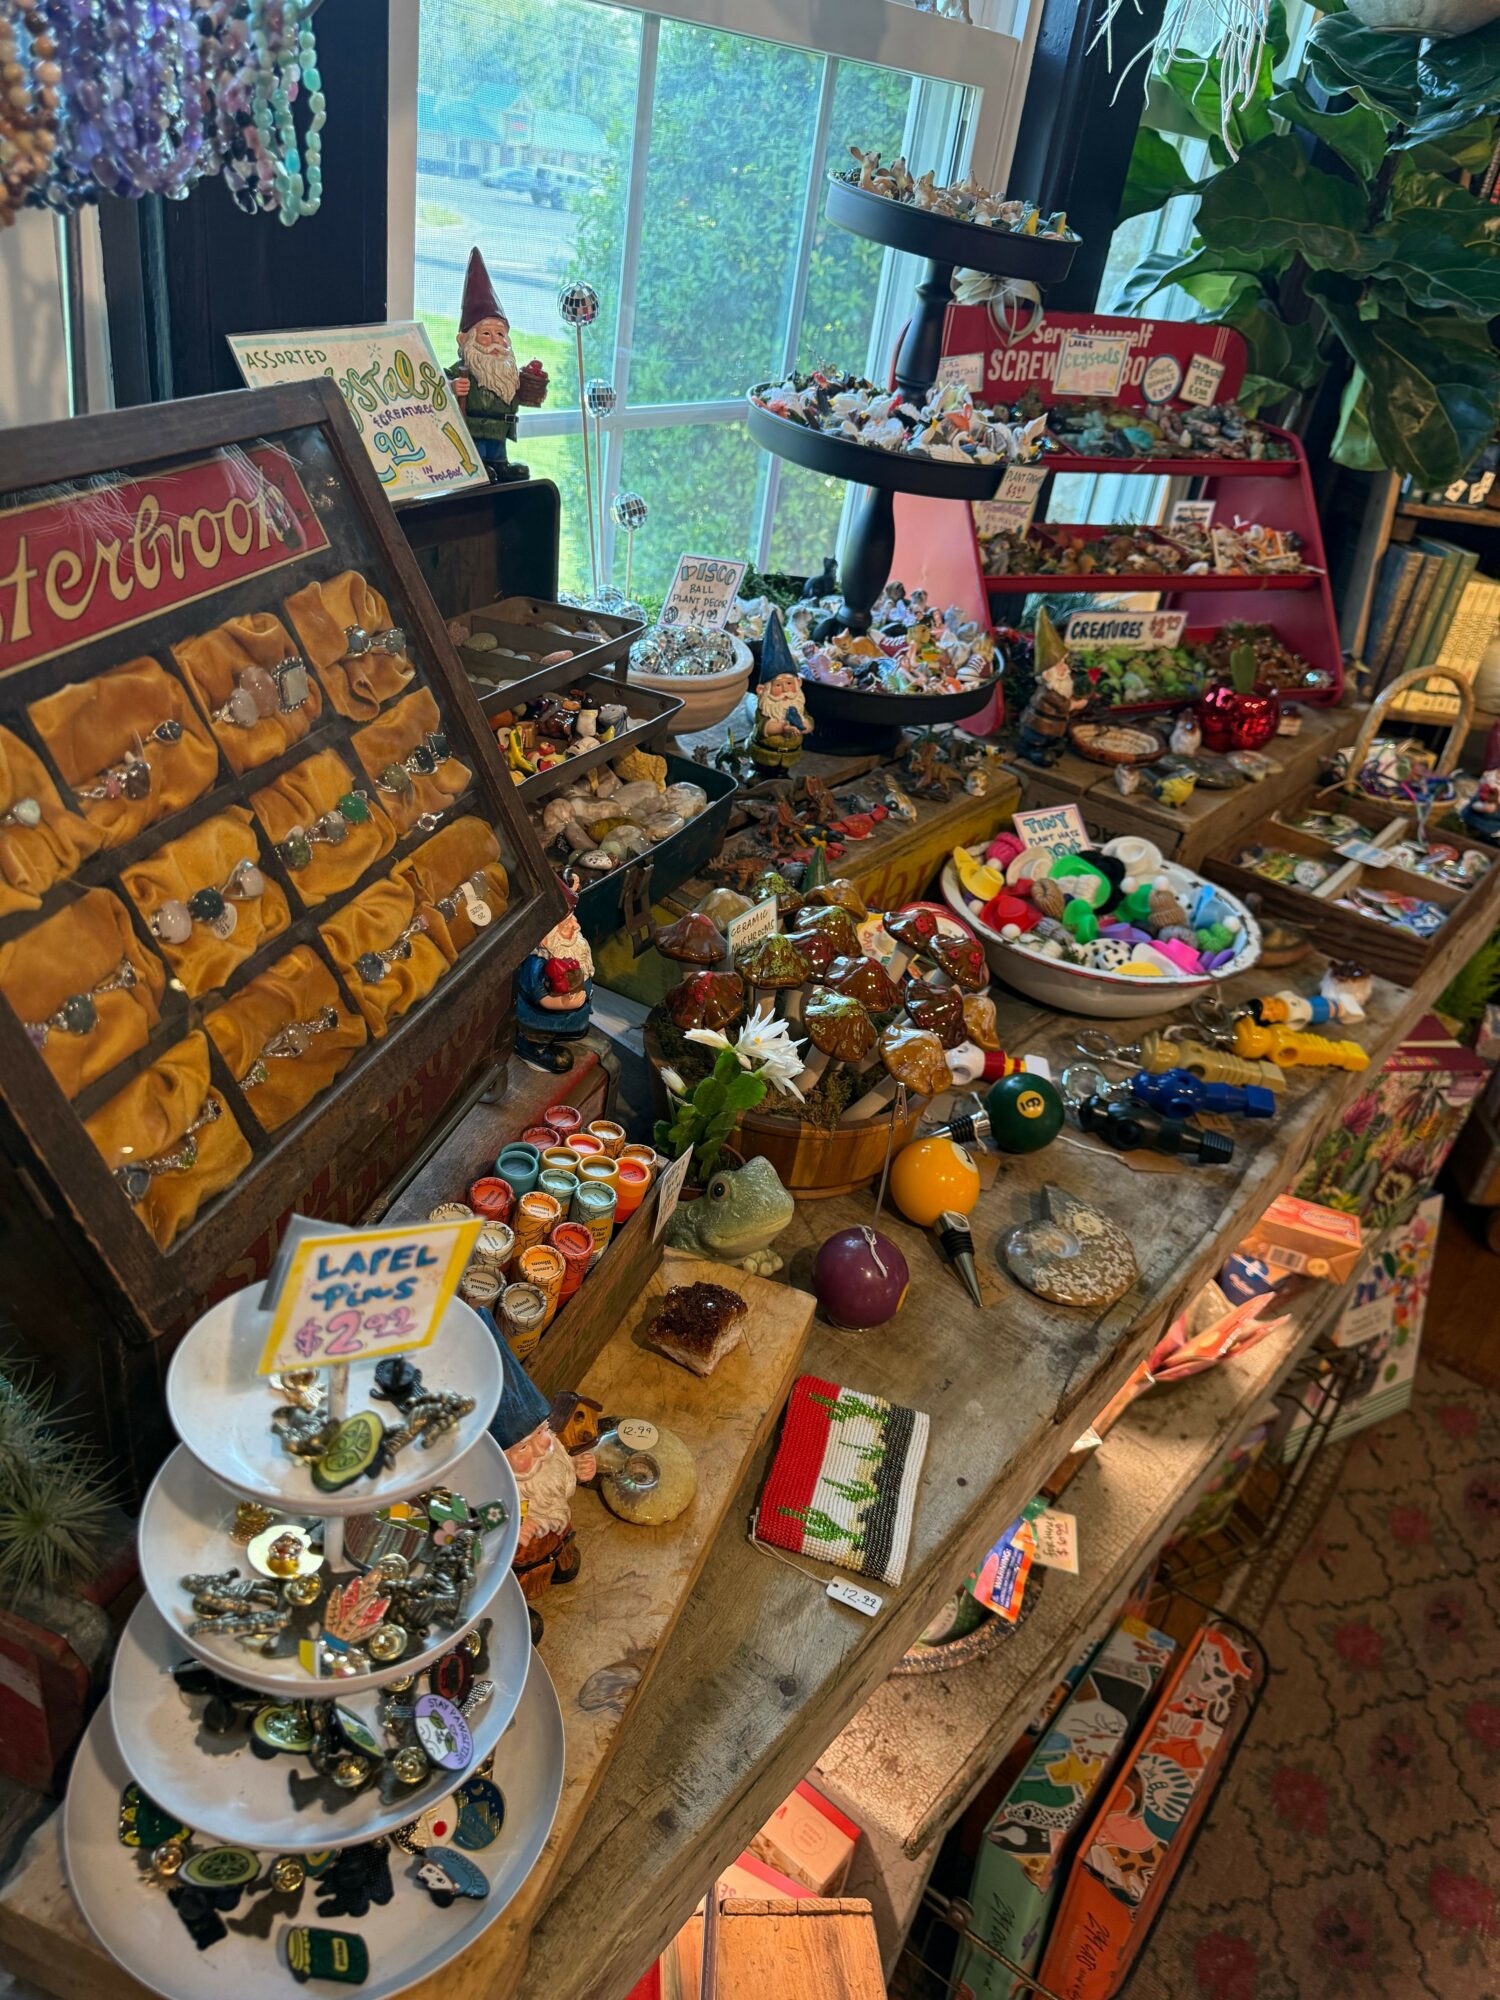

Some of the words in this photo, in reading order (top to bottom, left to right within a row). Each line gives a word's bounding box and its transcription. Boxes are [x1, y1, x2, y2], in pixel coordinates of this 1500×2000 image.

[246, 350, 327, 369] ASSORTED
[422, 465, 434, 476] IN
[0, 464, 292, 643] terbrook
[681, 563, 737, 586] DISCO
[689, 584, 713, 594] BALL
[673, 594, 700, 606] PLANT
[703, 598, 728, 609] DECOR
[1070, 619, 1143, 640] CREATURES
[1023, 811, 1069, 834] TINY
[731, 909, 768, 937] CERAMIC
[317, 1243, 438, 1281] LAPEL
[469, 1277, 496, 1289] Coconut
[512, 1297, 531, 1310] Island
[622, 1425, 653, 1438] 12.99
[841, 1586, 878, 1610] 12.99
[428, 1698, 449, 1711] STAY
